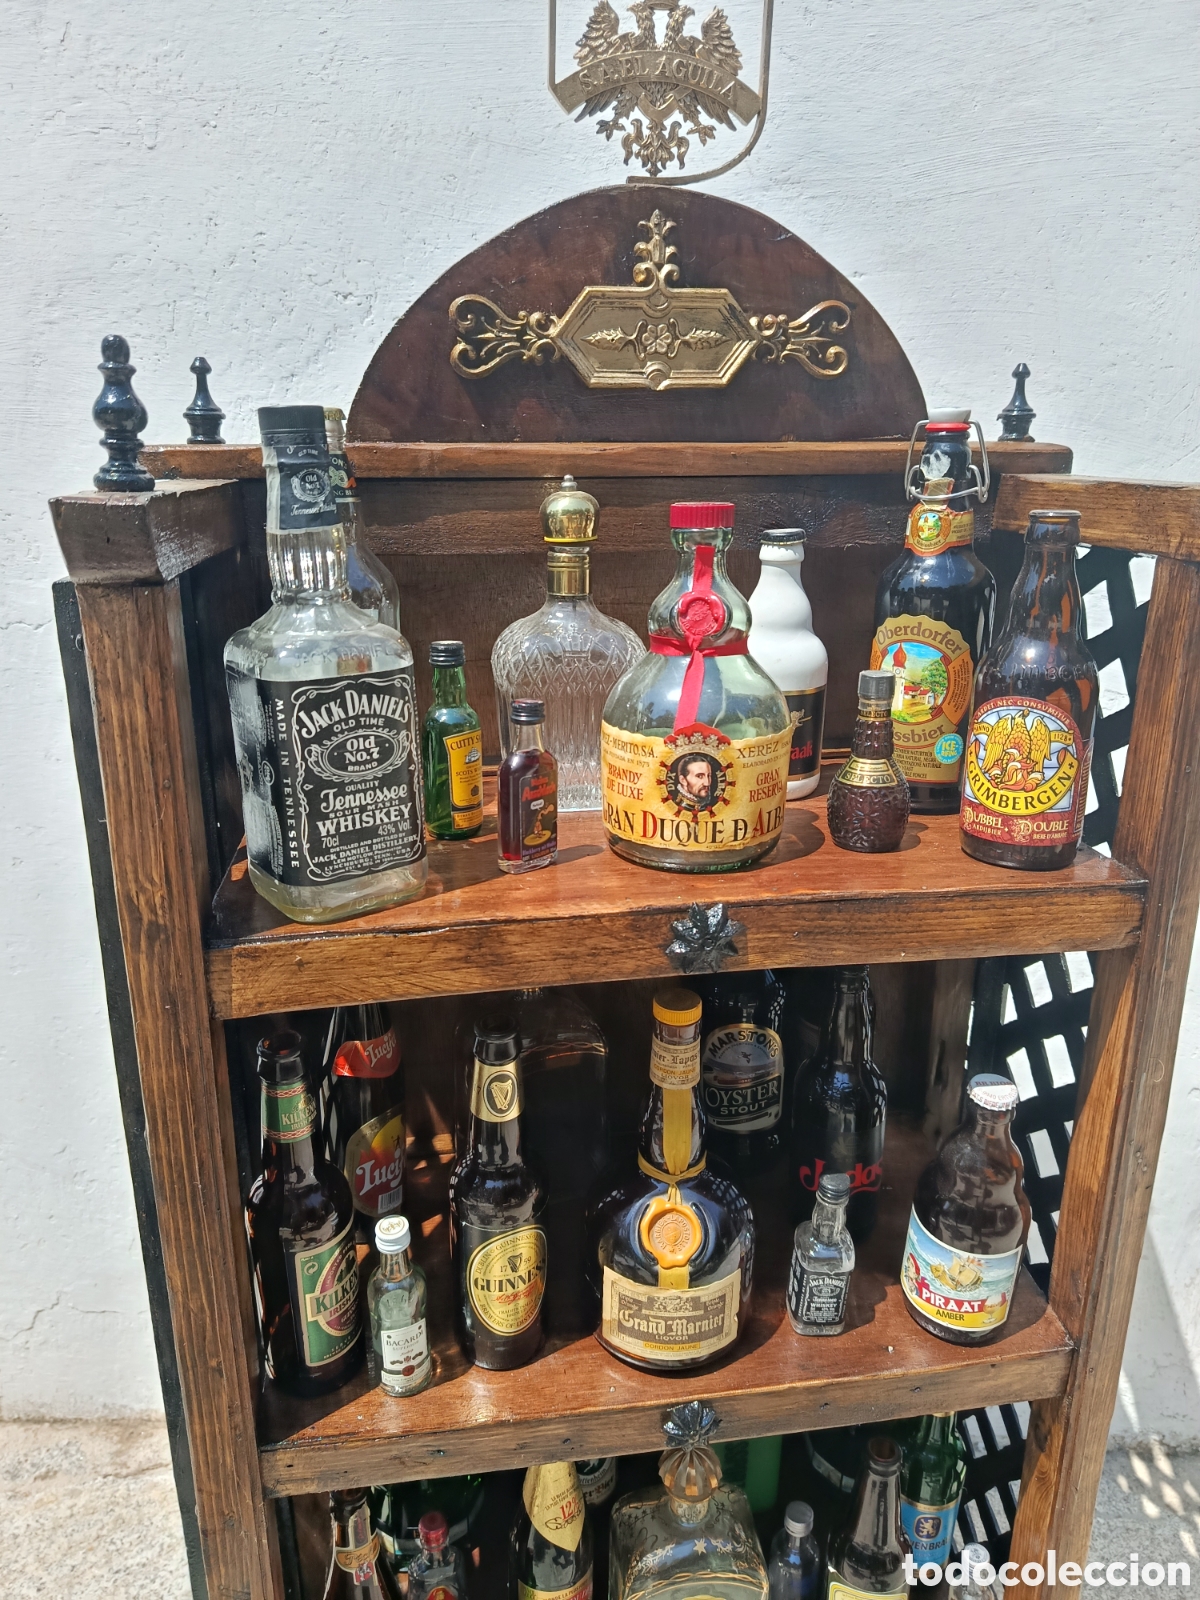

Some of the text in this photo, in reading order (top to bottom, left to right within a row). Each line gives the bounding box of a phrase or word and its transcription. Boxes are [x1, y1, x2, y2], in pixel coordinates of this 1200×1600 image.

[655, 54, 737, 101] AGUILA
[305, 474, 318, 482] Old
[876, 622, 962, 655] Oberdorfer
[298, 698, 346, 738] JACK
[345, 690, 412, 724] DANIEL'S
[333, 717, 385, 732] OLD TIME
[860, 710, 888, 718] SELECTO
[346, 736, 376, 752] Old
[450, 736, 475, 751] CUTTY
[892, 724, 945, 743] ssbier
[736, 740, 780, 760] XEREZ
[347, 762, 378, 772] BRAND
[608, 762, 642, 785] BRANDY
[756, 767, 780, 786] GRAN
[844, 772, 891, 784] SELECTO
[275, 698, 300, 868] MADE IN TENNESSEE
[345, 780, 380, 792] QUALITY
[606, 777, 644, 802] DE LUXE
[749, 780, 783, 803] RESERVA
[968, 760, 1072, 811] GRIMBERGEN
[320, 784, 408, 813] Tennessee
[329, 800, 400, 819] SOUR MASH
[316, 802, 412, 837] WHISKEY
[602, 794, 635, 836] GRAN
[641, 810, 726, 847] DUQUE
[963, 806, 1004, 830] DUBBEL
[1016, 820, 1069, 837] DOUBLE
[321, 819, 412, 849] 70cl 43% Vol.
[312, 834, 418, 864] JACK DANIEL DISTILLERY
[330, 842, 359, 853] DISTILLED
[708, 1030, 779, 1058] MARSTON'S
[706, 1080, 779, 1108] OYSTER
[720, 1100, 768, 1114] STOUT
[500, 1256, 532, 1274] 17 59
[329, 1296, 350, 1318] IRISH
[922, 1287, 982, 1312] PIRAAT
[480, 1304, 504, 1328] BREWERS
[505, 1321, 514, 1329] OF
[619, 1310, 724, 1336] Grand Marnier
[936, 1310, 965, 1321] AMBER
[386, 1330, 424, 1346] BACARDI
[644, 1342, 674, 1351] CORDON
[560, 1495, 579, 1520] 12%
